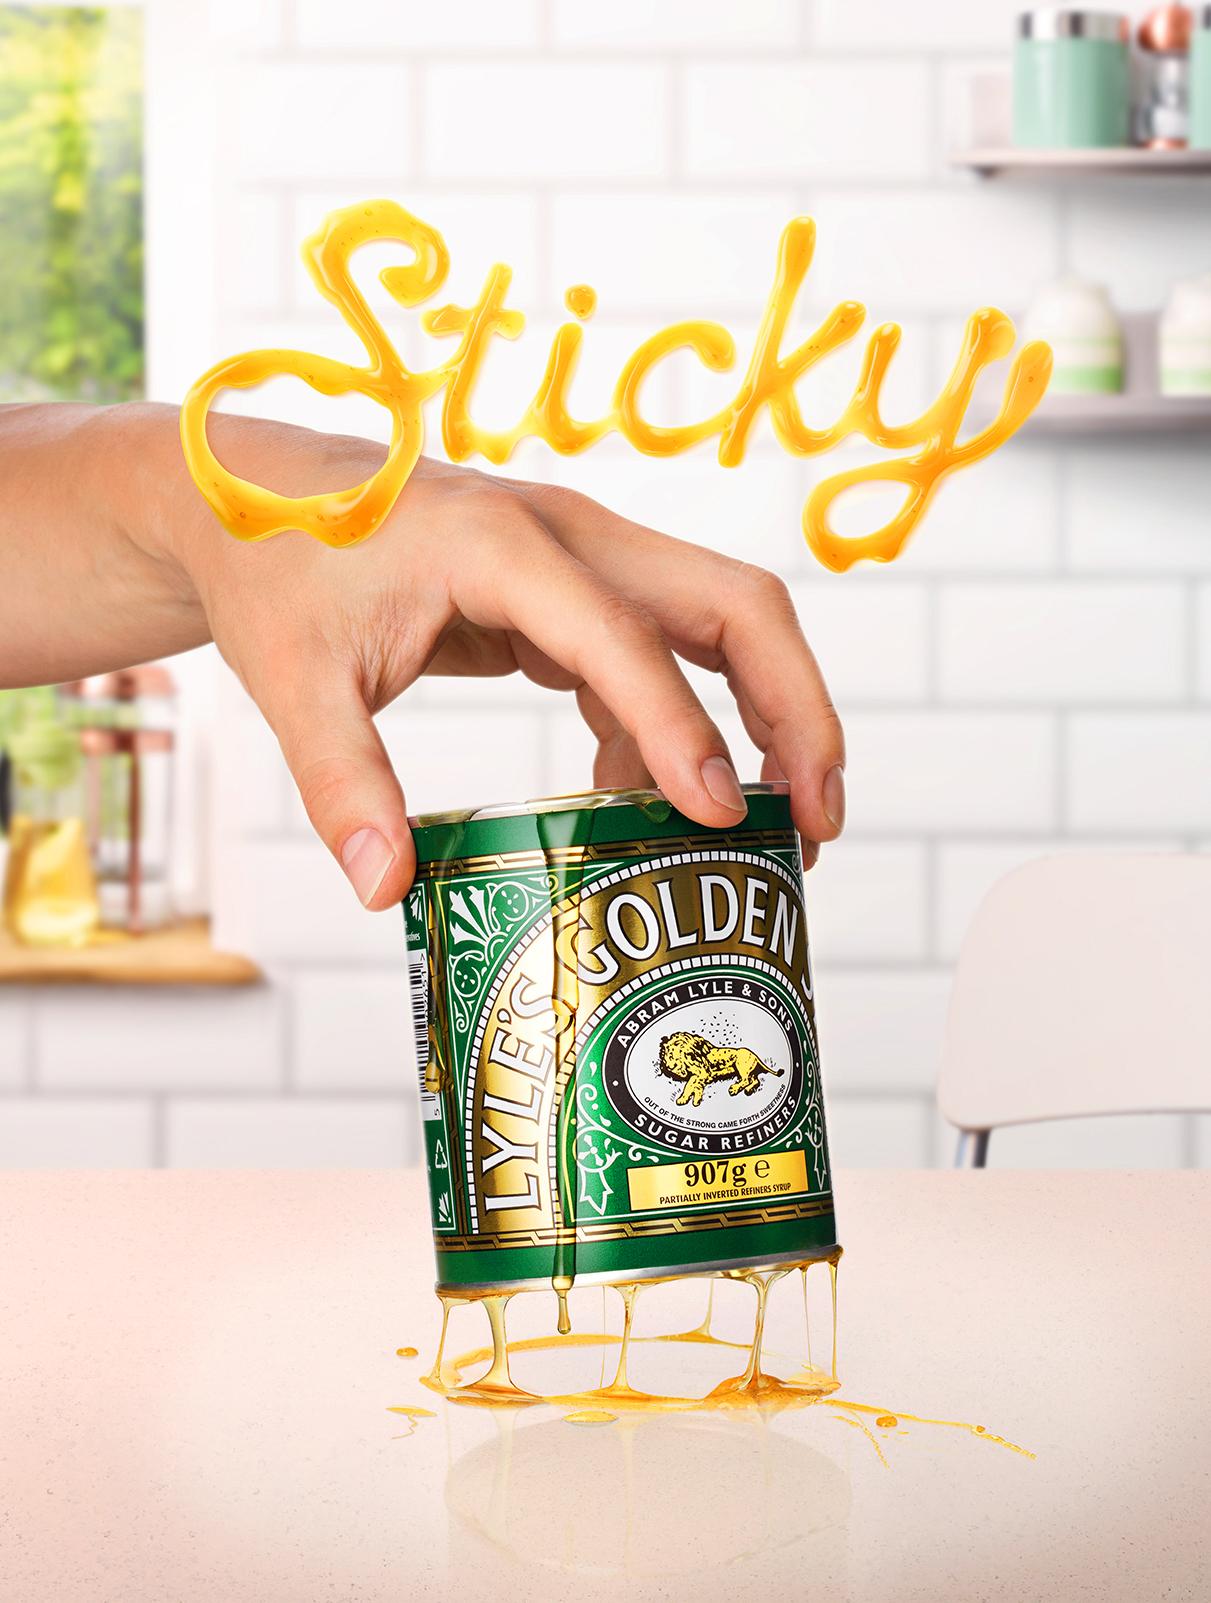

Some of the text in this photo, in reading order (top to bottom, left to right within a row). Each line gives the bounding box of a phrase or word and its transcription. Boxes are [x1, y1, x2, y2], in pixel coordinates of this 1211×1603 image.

[617, 981, 792, 1049] ABRAM LYLE & SONS
[480, 873, 799, 1214] LYLE'S GOLDEN
[634, 1096, 797, 1150] SUGAR REFINERS
[644, 1084, 786, 1129] OUT OF THE STRONG CAME FORTH SWEETNESS
[659, 1182, 792, 1205] PARTIALLY INVERTED REFINERS SYRUP
[684, 1160, 747, 1187] 907g
